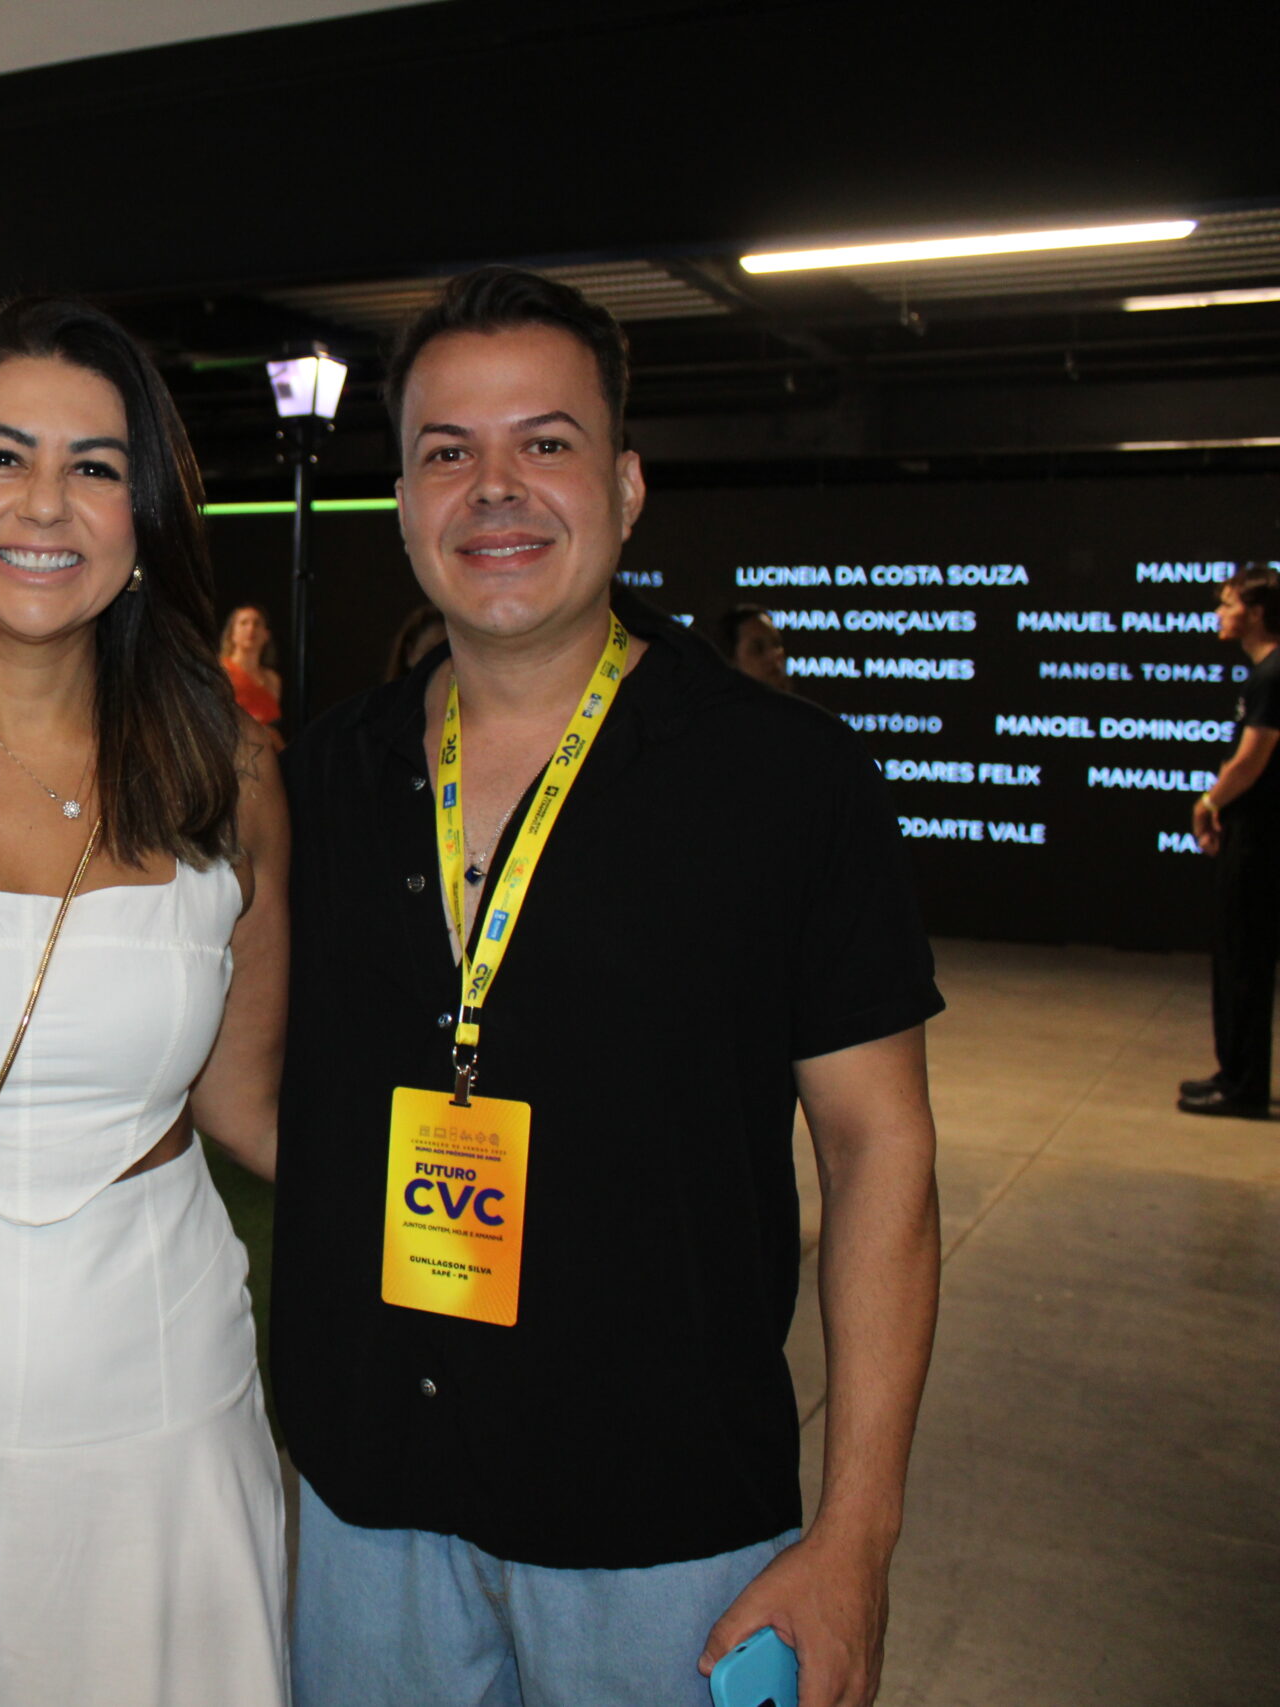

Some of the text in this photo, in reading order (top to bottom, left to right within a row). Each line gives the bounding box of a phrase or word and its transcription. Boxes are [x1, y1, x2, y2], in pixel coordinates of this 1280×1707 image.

[616, 570, 664, 588] TIAS
[835, 566, 868, 586] DA
[870, 565, 943, 586] COSTA
[947, 565, 1029, 586] SOUZA
[769, 610, 977, 635] IMARA GONÇALVES
[1017, 611, 1117, 633] MANUEL
[864, 658, 976, 681] MARQUES
[1039, 662, 1133, 681] MANOEL
[1140, 663, 1224, 683] TOMAZ
[995, 714, 1096, 738] MANOEL
[445, 734, 458, 765] CVC
[556, 733, 581, 767] CVC
[885, 759, 975, 784] SOARES
[978, 763, 1042, 786] FELIX
[987, 821, 1047, 844] VALE
[467, 963, 489, 1000] CVC
[415, 1162, 476, 1182] FUTURO
[404, 1178, 506, 1226] CVC
[402, 1221, 427, 1230] JUNTOS
[451, 1228, 469, 1237] HOJE
[431, 1269, 451, 1278] SAPÉ
[468, 1265, 492, 1275] SILVA
